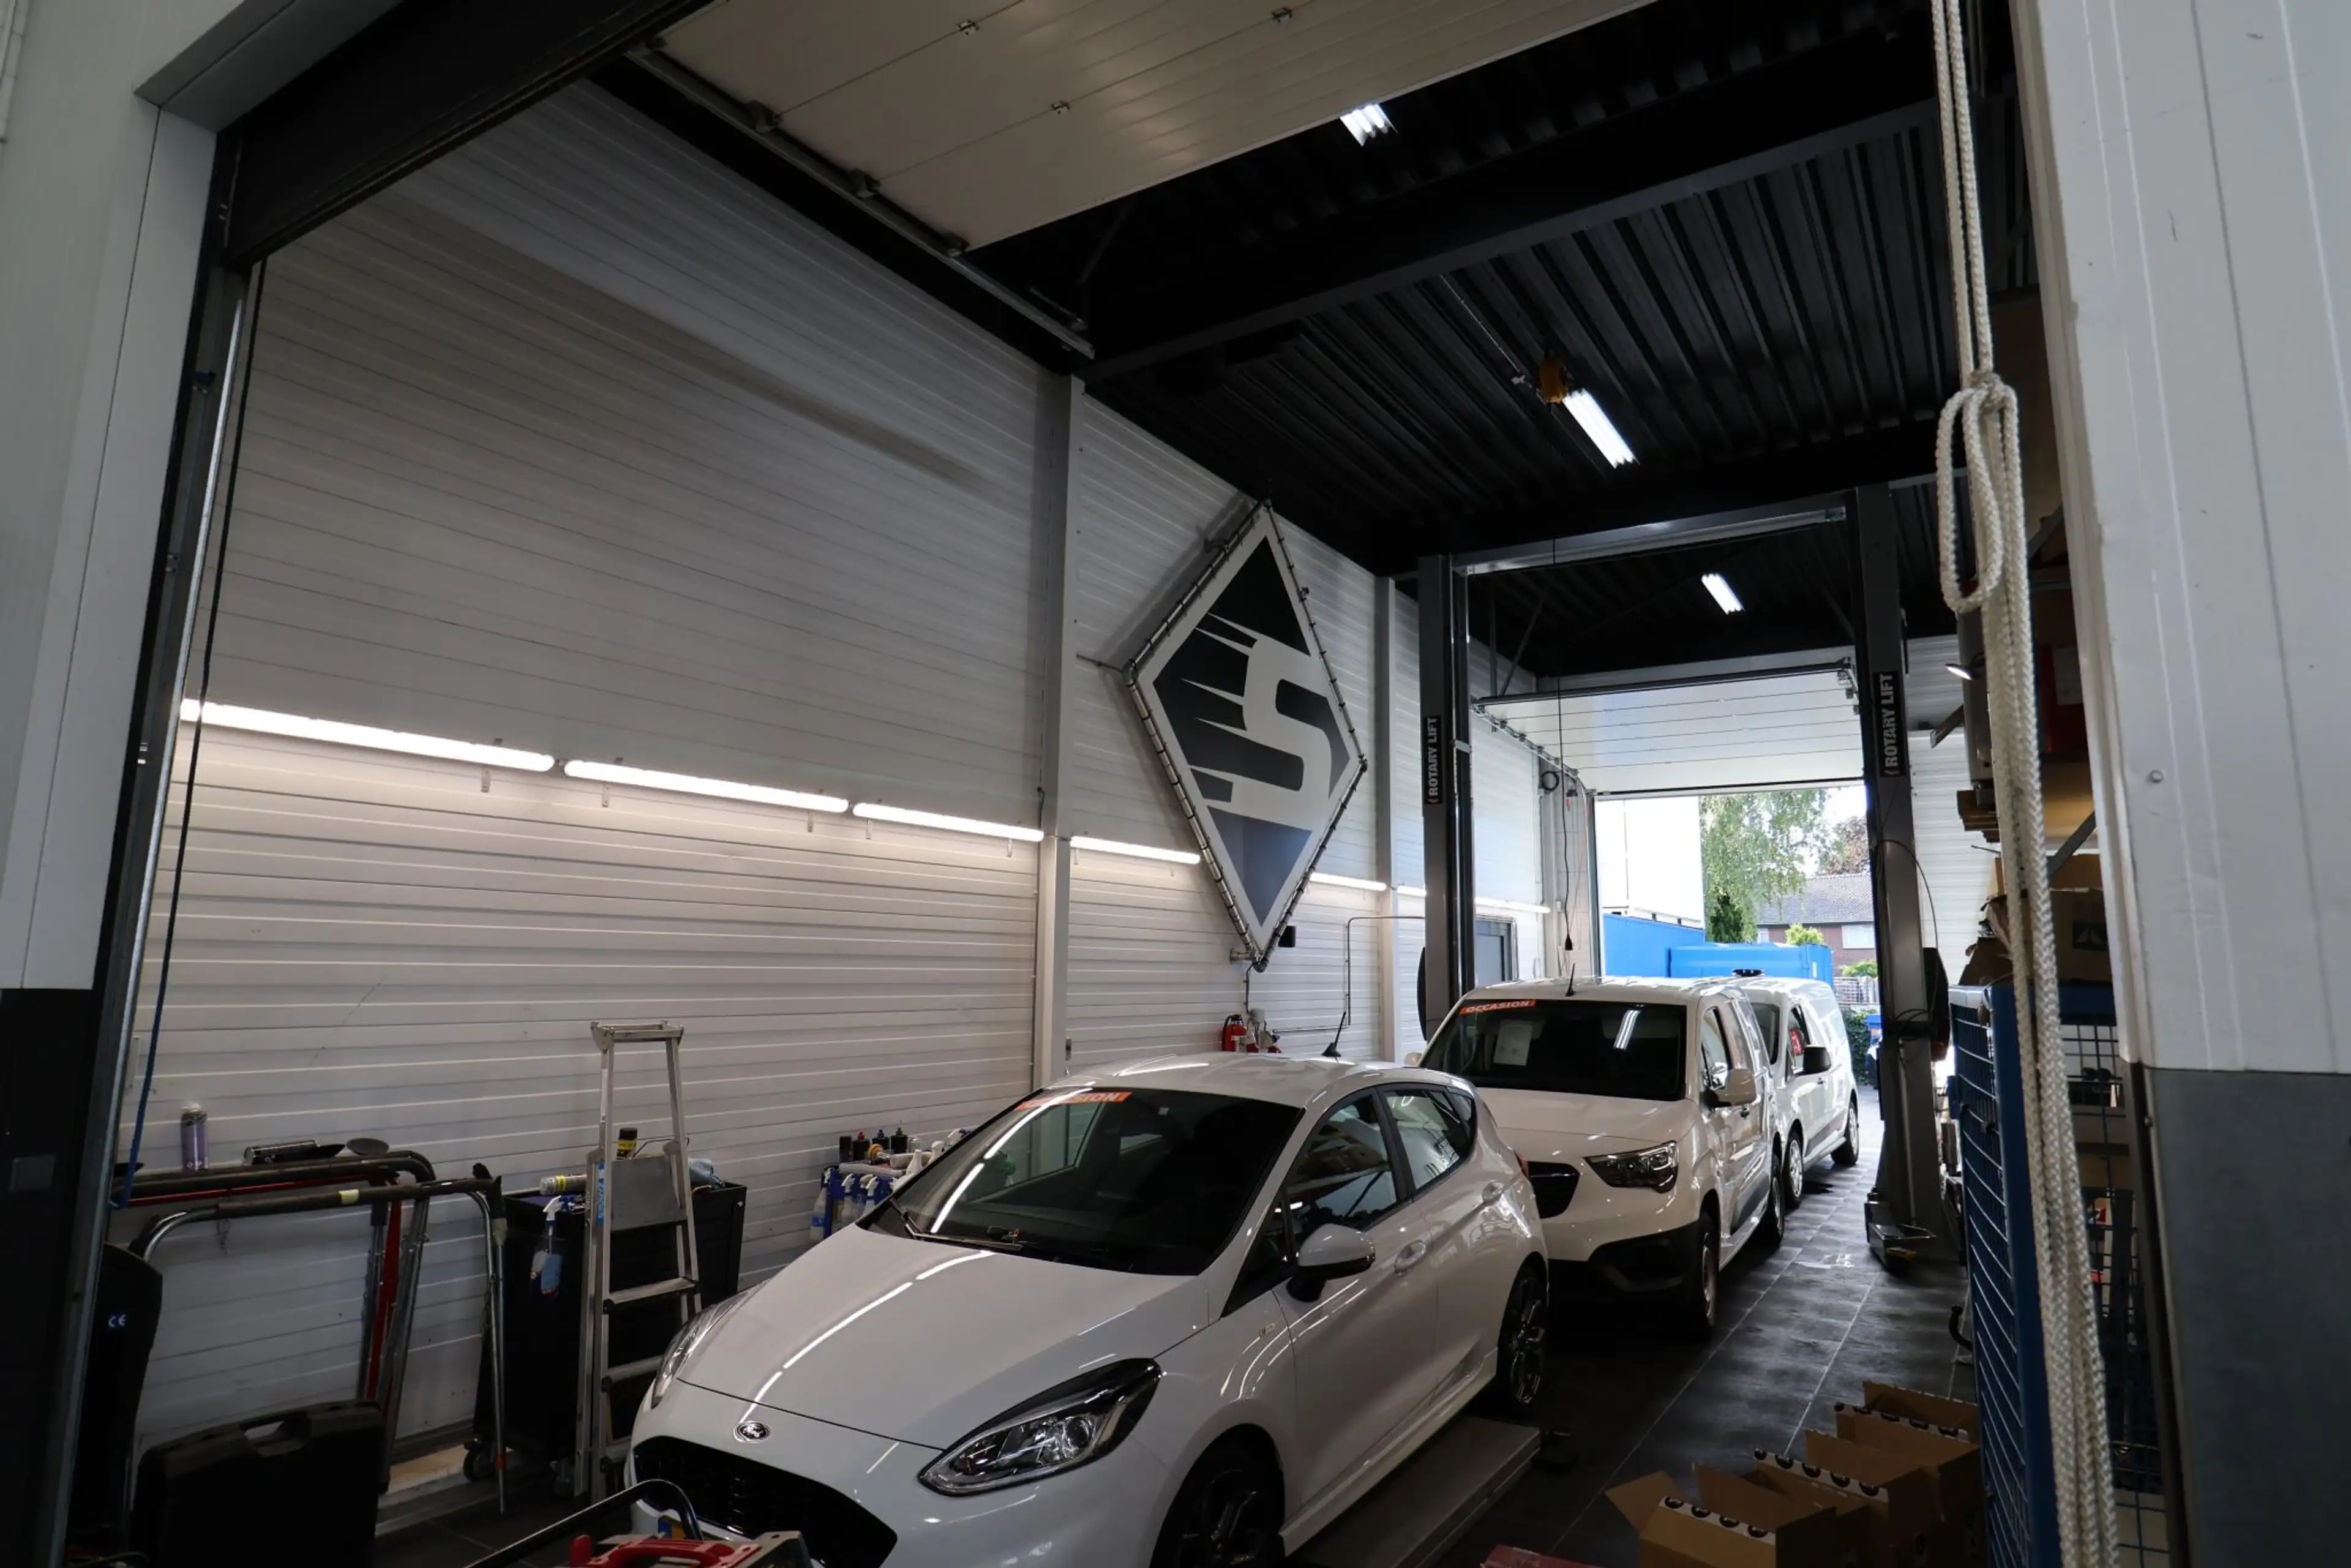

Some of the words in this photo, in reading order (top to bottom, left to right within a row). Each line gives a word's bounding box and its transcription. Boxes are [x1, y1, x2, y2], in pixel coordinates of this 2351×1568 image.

[1879, 673, 1895, 705] LIFT
[1427, 717, 1438, 744] LIFT
[1881, 708, 1899, 767] ROTARY
[1427, 745, 1439, 796] ROTARY
[1466, 1000, 1529, 1013] OCCASION
